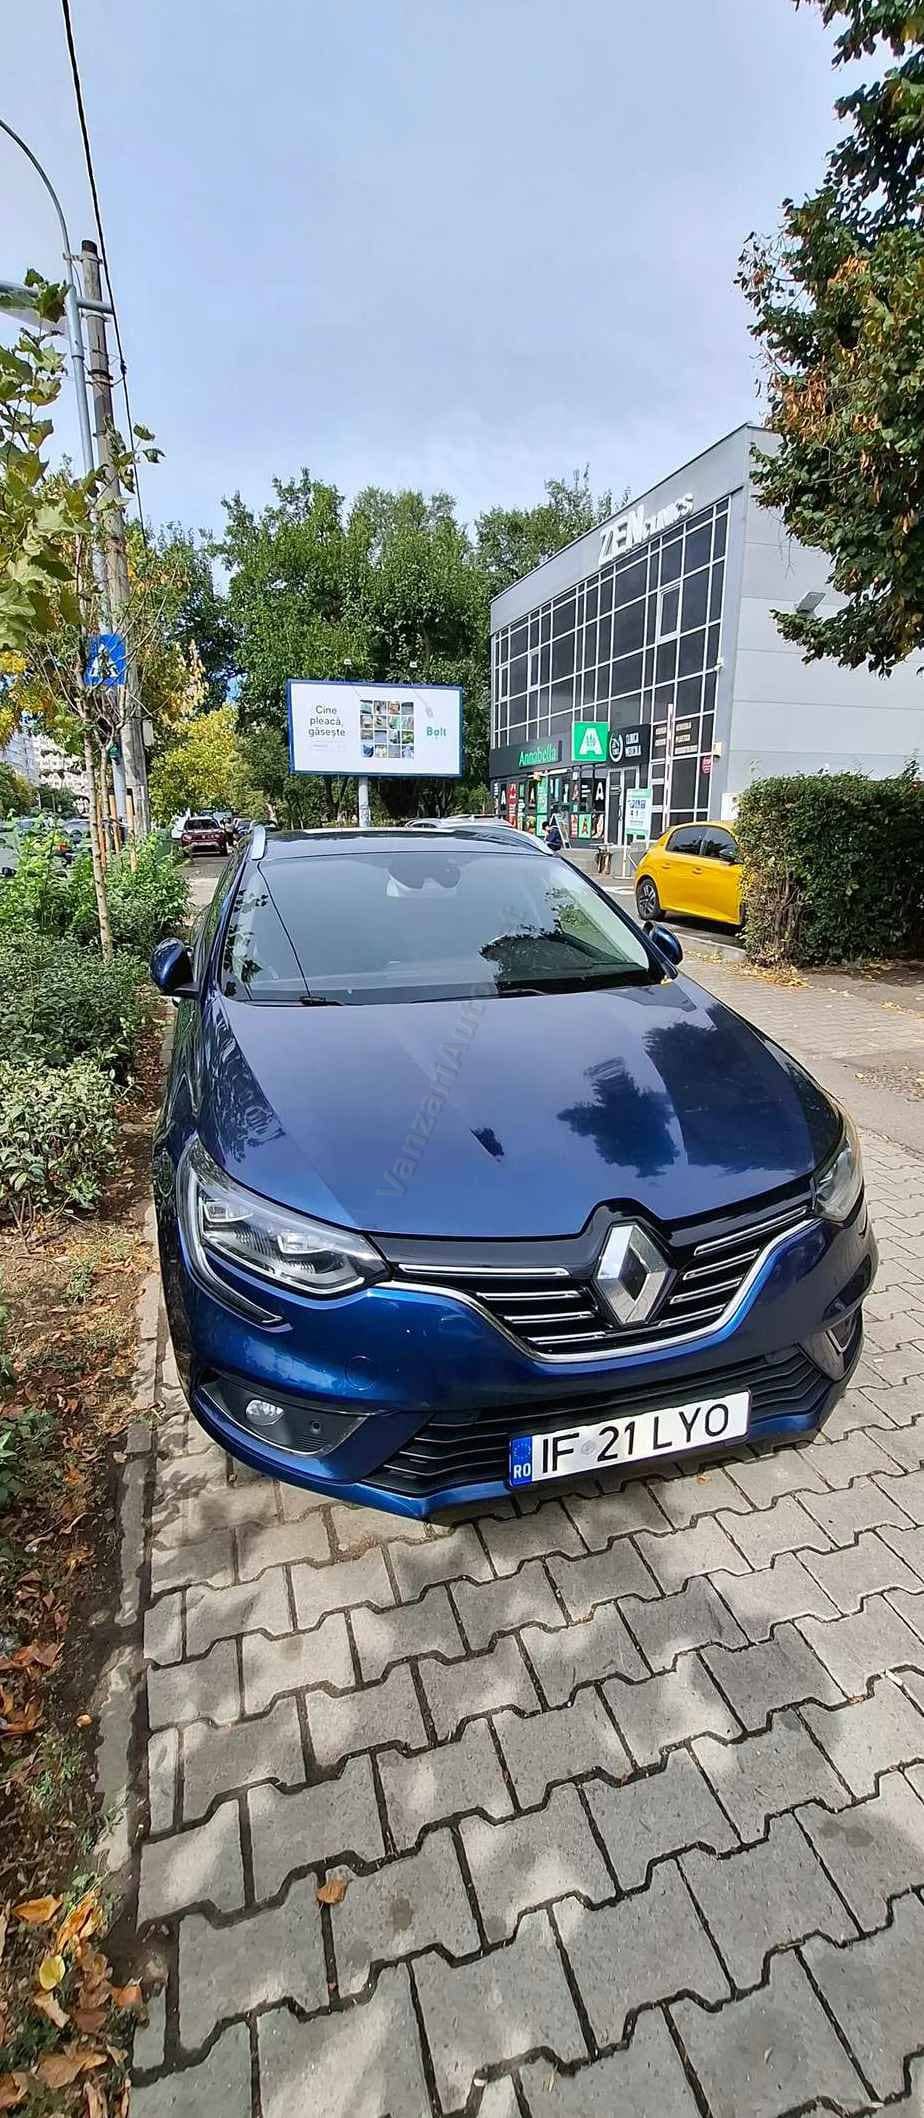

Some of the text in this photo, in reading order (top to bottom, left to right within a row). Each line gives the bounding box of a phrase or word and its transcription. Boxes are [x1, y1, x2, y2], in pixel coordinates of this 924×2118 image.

[315, 704, 337, 715] Cine
[308, 727, 346, 739] găsește
[426, 726, 447, 738] Bolt
[518, 743, 557, 766] Annabella
[542, 1403, 729, 1474] IF 21 LYO
[513, 1463, 531, 1479] RO
